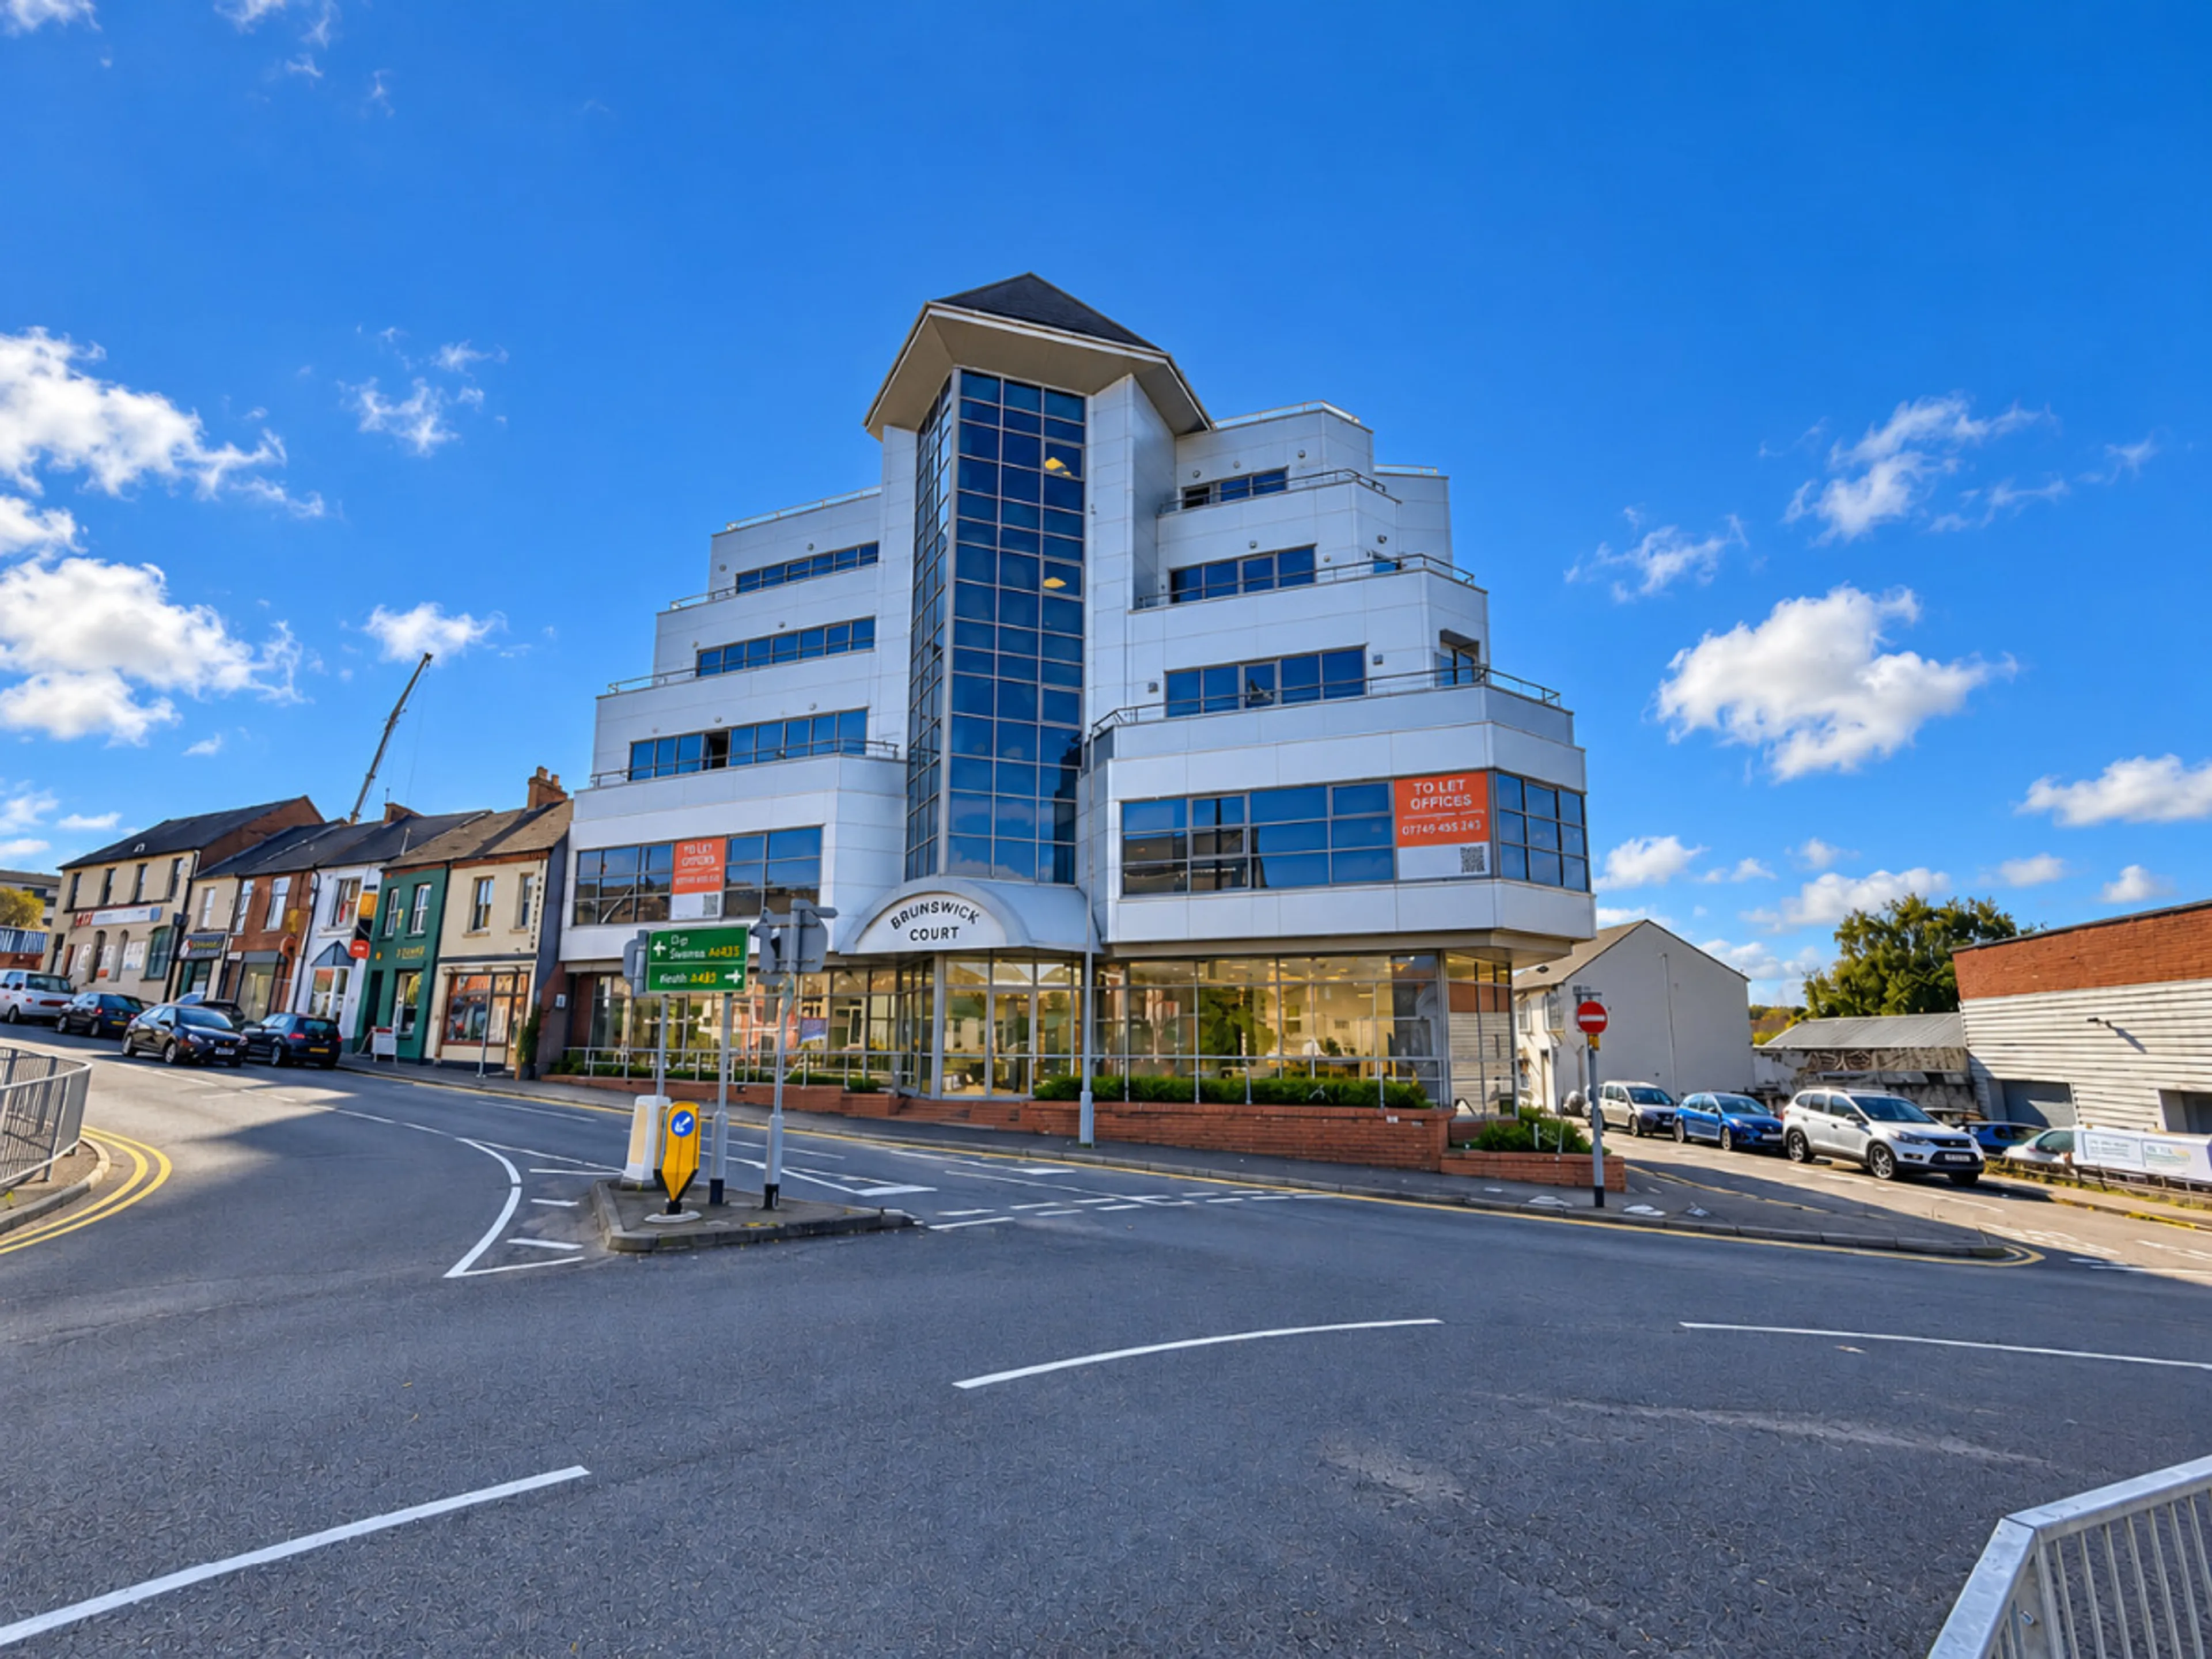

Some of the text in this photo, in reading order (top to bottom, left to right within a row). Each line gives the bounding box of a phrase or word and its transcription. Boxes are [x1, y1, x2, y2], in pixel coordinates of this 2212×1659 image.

[1413, 779, 1466, 795] TO LET
[1410, 794, 1472, 810] OFFICES
[890, 901, 980, 930] BRUNSWICK
[910, 926, 959, 941] COURT
